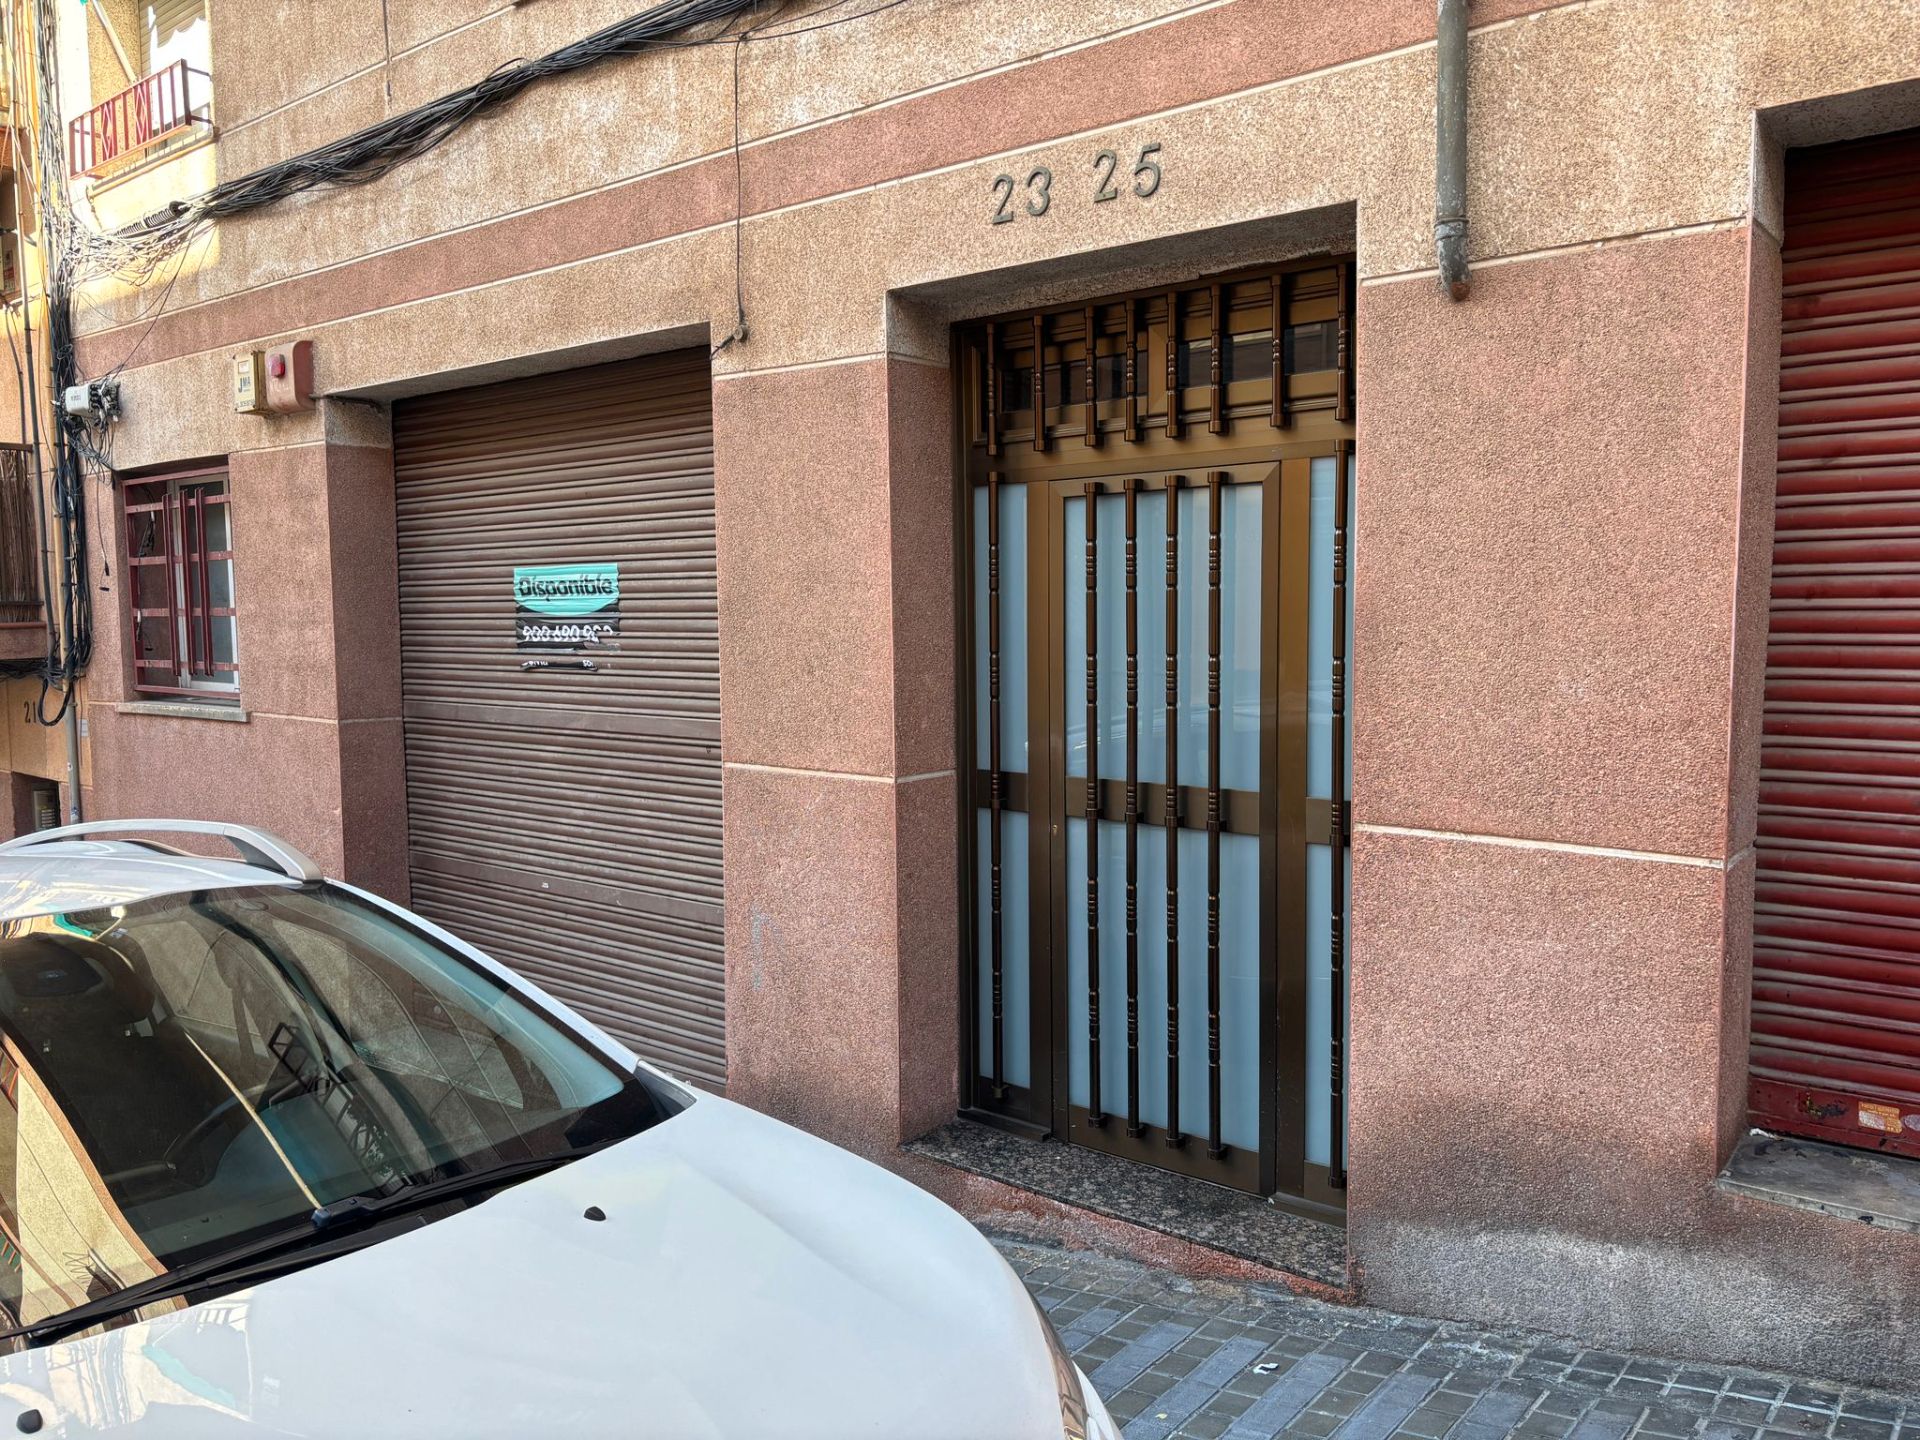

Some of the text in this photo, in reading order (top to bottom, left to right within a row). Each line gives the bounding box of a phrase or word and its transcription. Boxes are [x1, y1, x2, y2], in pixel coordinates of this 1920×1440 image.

[993, 143, 1162, 225] 23 25
[518, 574, 614, 602] Disponible
[24, 701, 37, 724] 21
